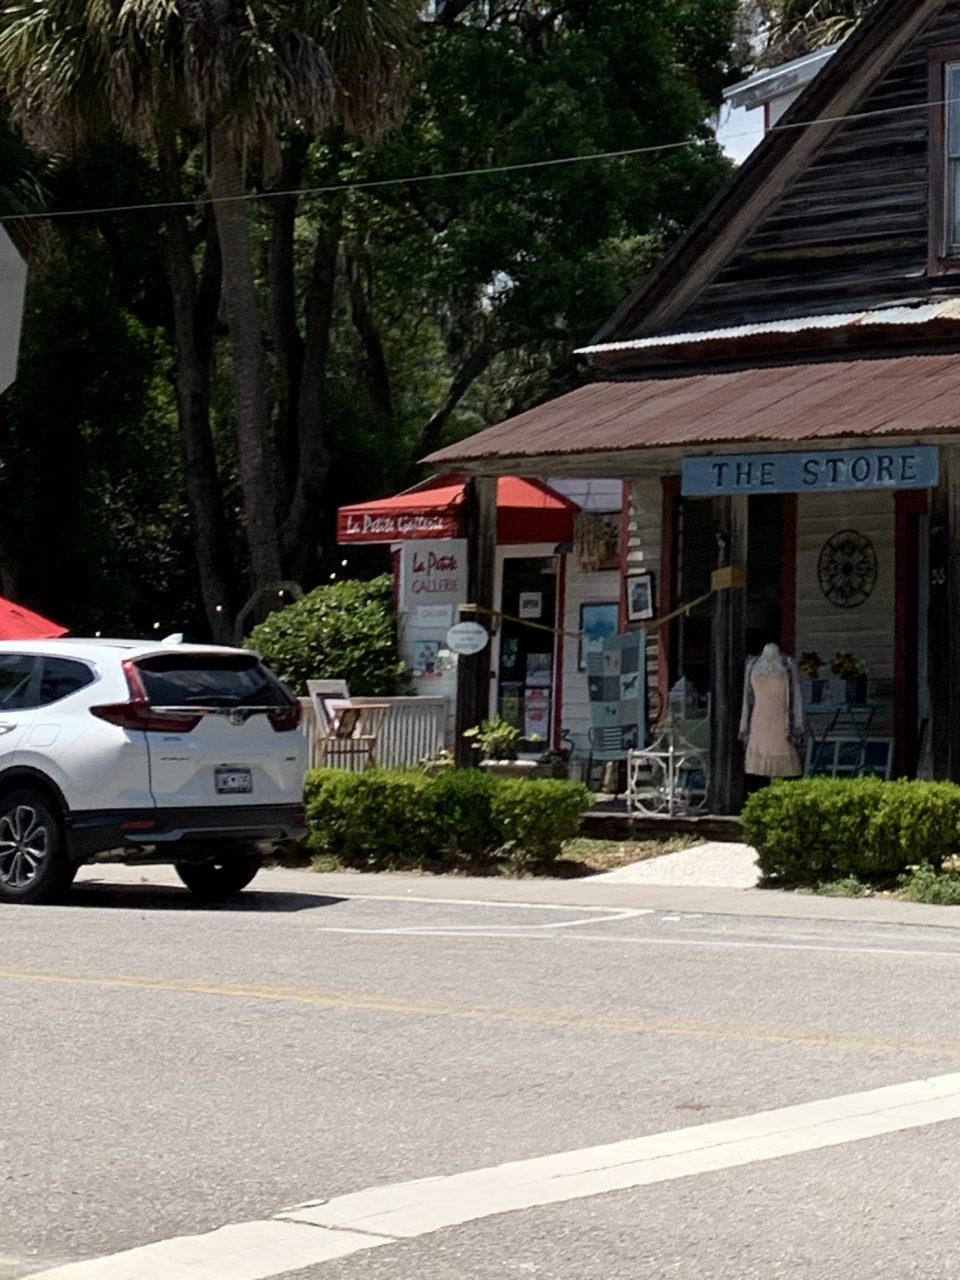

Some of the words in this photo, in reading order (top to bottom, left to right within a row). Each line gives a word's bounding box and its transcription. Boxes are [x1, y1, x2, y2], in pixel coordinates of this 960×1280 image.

[711, 462, 776, 487] THE
[802, 454, 917, 485] STORE
[346, 516, 360, 534] La
[362, 514, 395, 534] Petite
[412, 552, 425, 573] La
[427, 551, 458, 576] Petite
